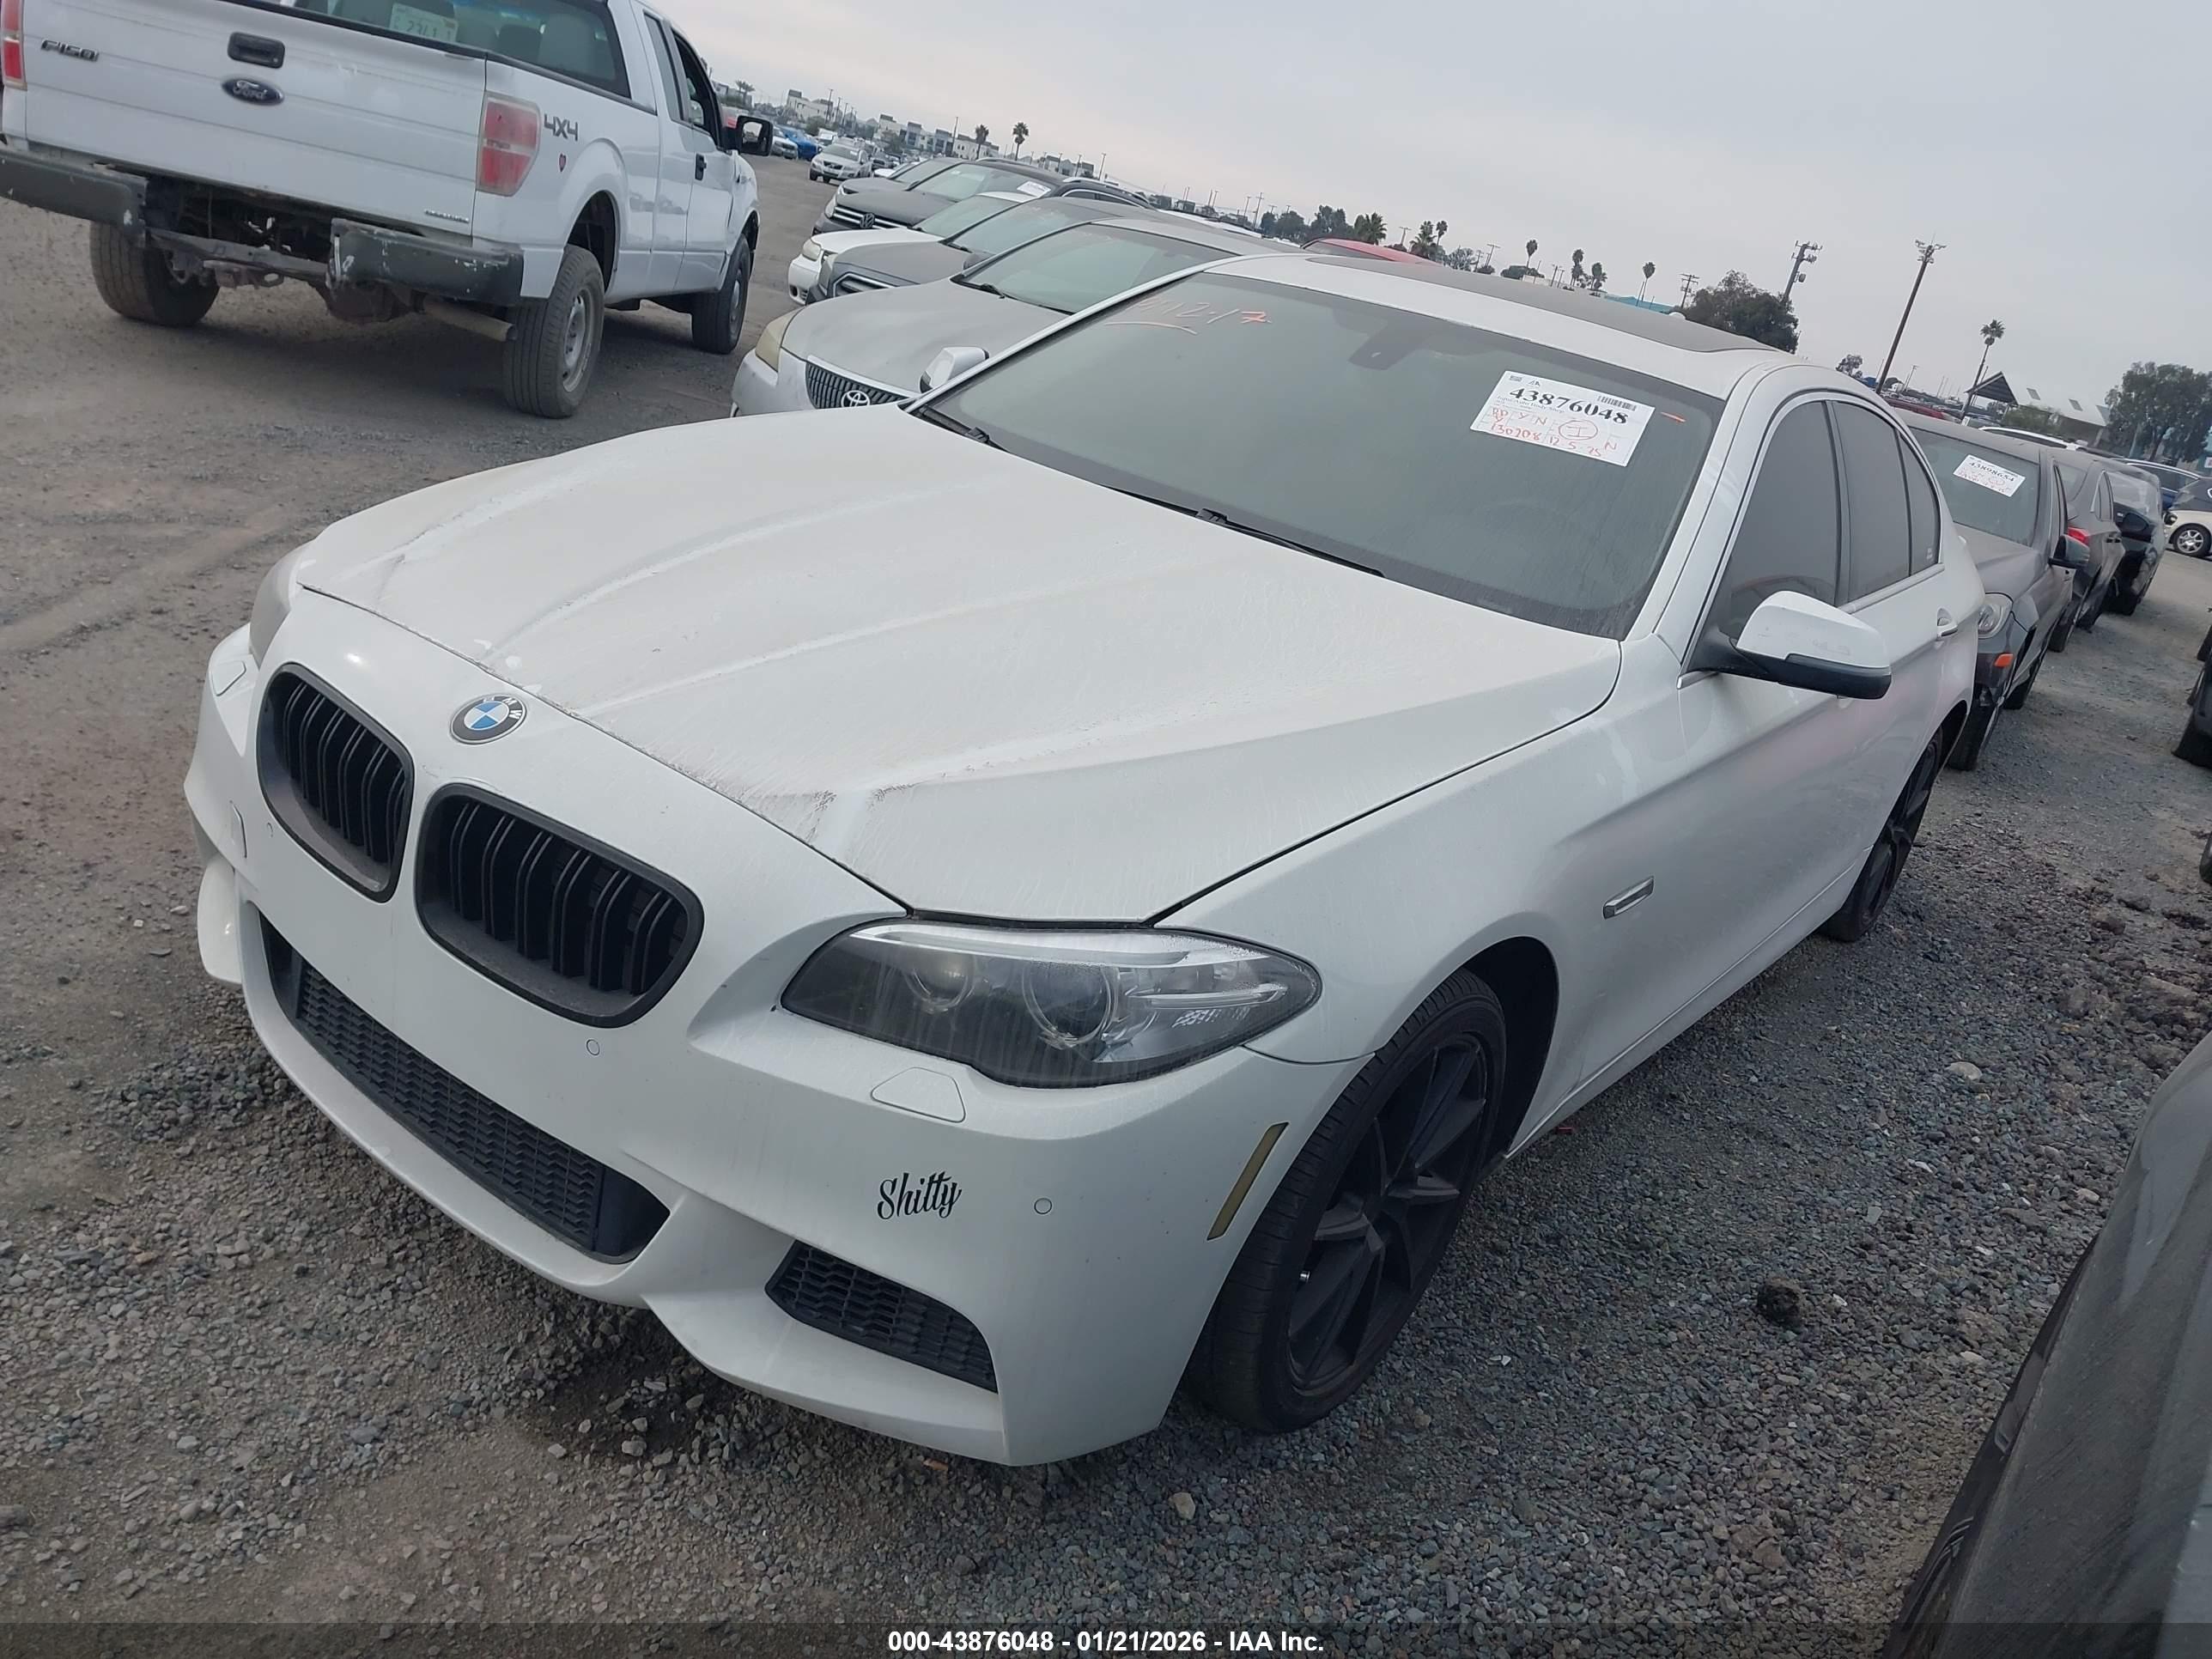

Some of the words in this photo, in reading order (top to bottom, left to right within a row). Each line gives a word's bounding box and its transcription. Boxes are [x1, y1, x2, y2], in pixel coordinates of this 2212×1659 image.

[233, 79, 267, 100] Ford
[1509, 388, 1629, 424] 43876048
[877, 1170, 963, 1220] Shitty
